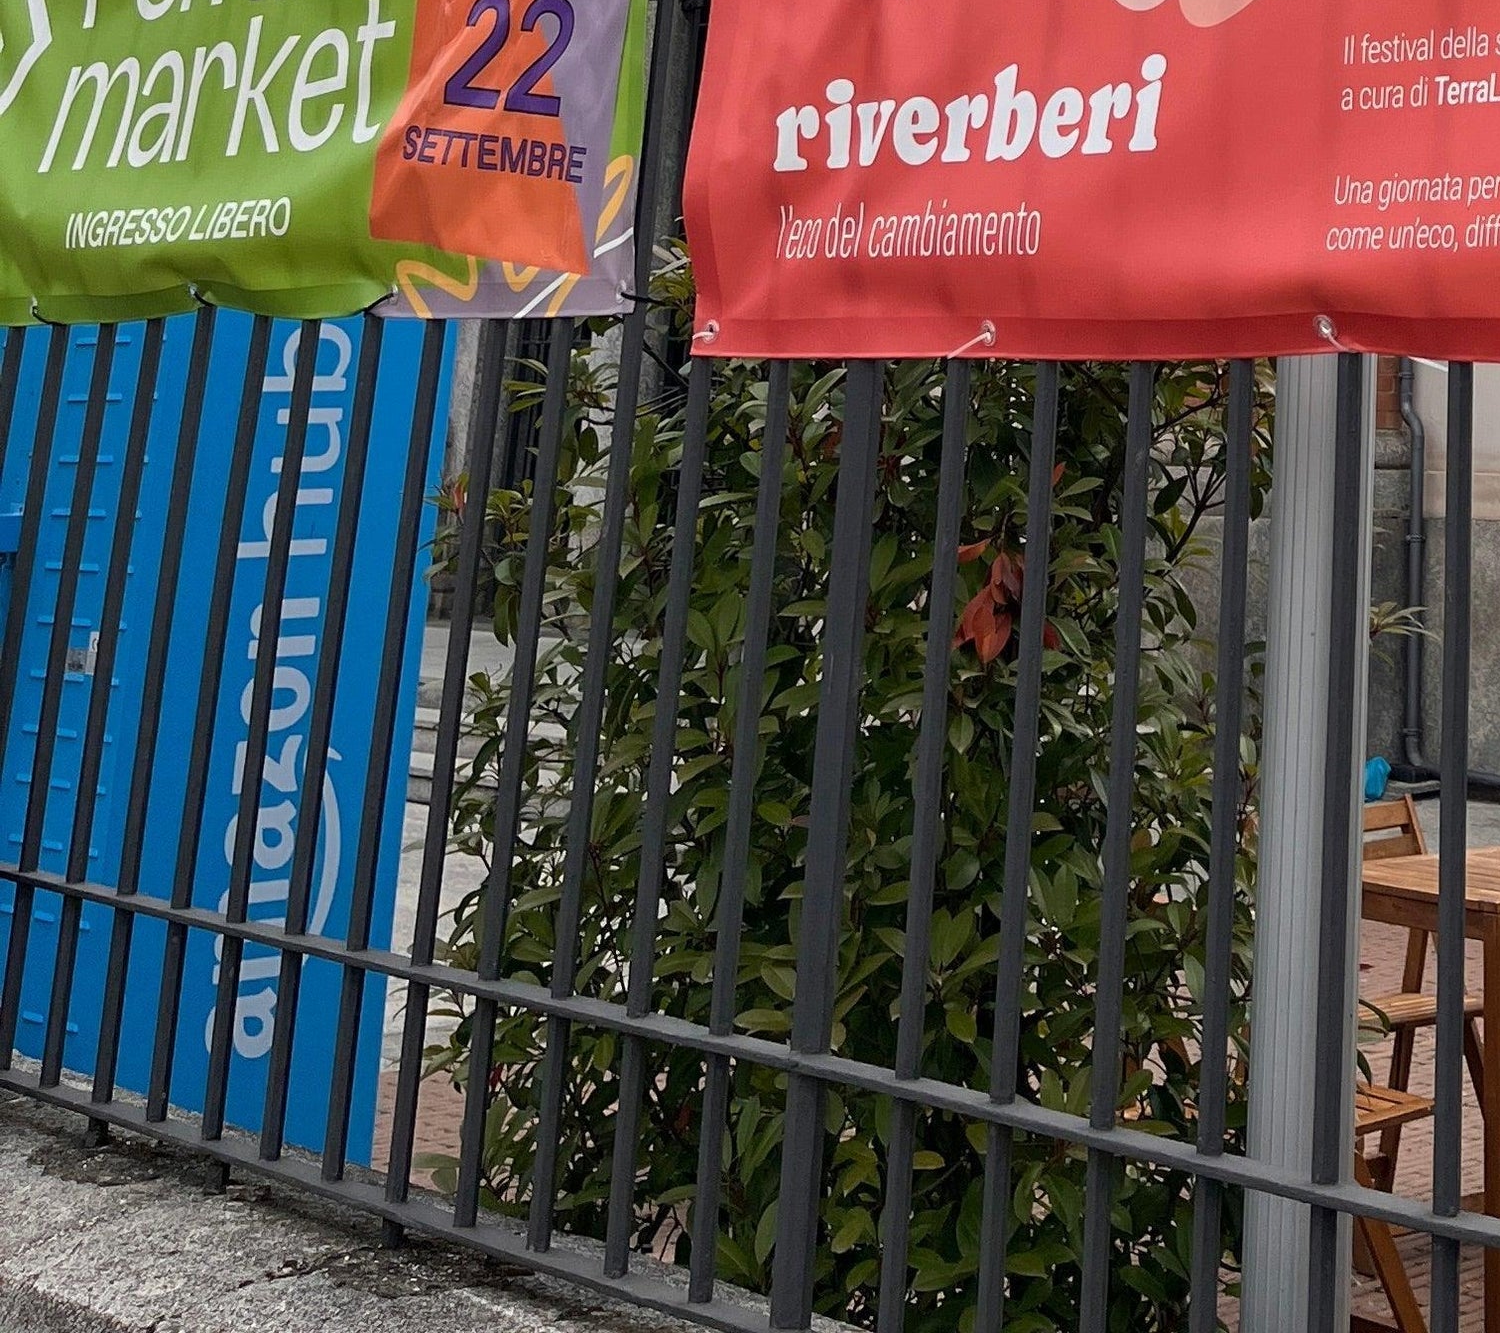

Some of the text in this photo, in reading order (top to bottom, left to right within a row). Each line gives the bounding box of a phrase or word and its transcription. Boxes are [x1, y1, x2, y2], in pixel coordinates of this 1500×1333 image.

[1343, 34, 1355, 65] Il
[1361, 30, 1434, 63] festival
[1440, 26, 1489, 60] della
[773, 53, 1167, 171] riverberi
[1340, 86, 1354, 111] a
[1359, 83, 1403, 110] cura
[1410, 76, 1429, 107] di
[402, 125, 588, 184] SETTEMBRE
[1334, 174, 1372, 205] Una
[1378, 173, 1462, 212] giornata
[65, 196, 291, 249] INGRESSO LIBERO
[776, 198, 1042, 259] l'eco del cambiamento
[1325, 224, 1383, 251] come
[1388, 216, 1460, 253] un'eco,
[237, 322, 352, 559] hub
